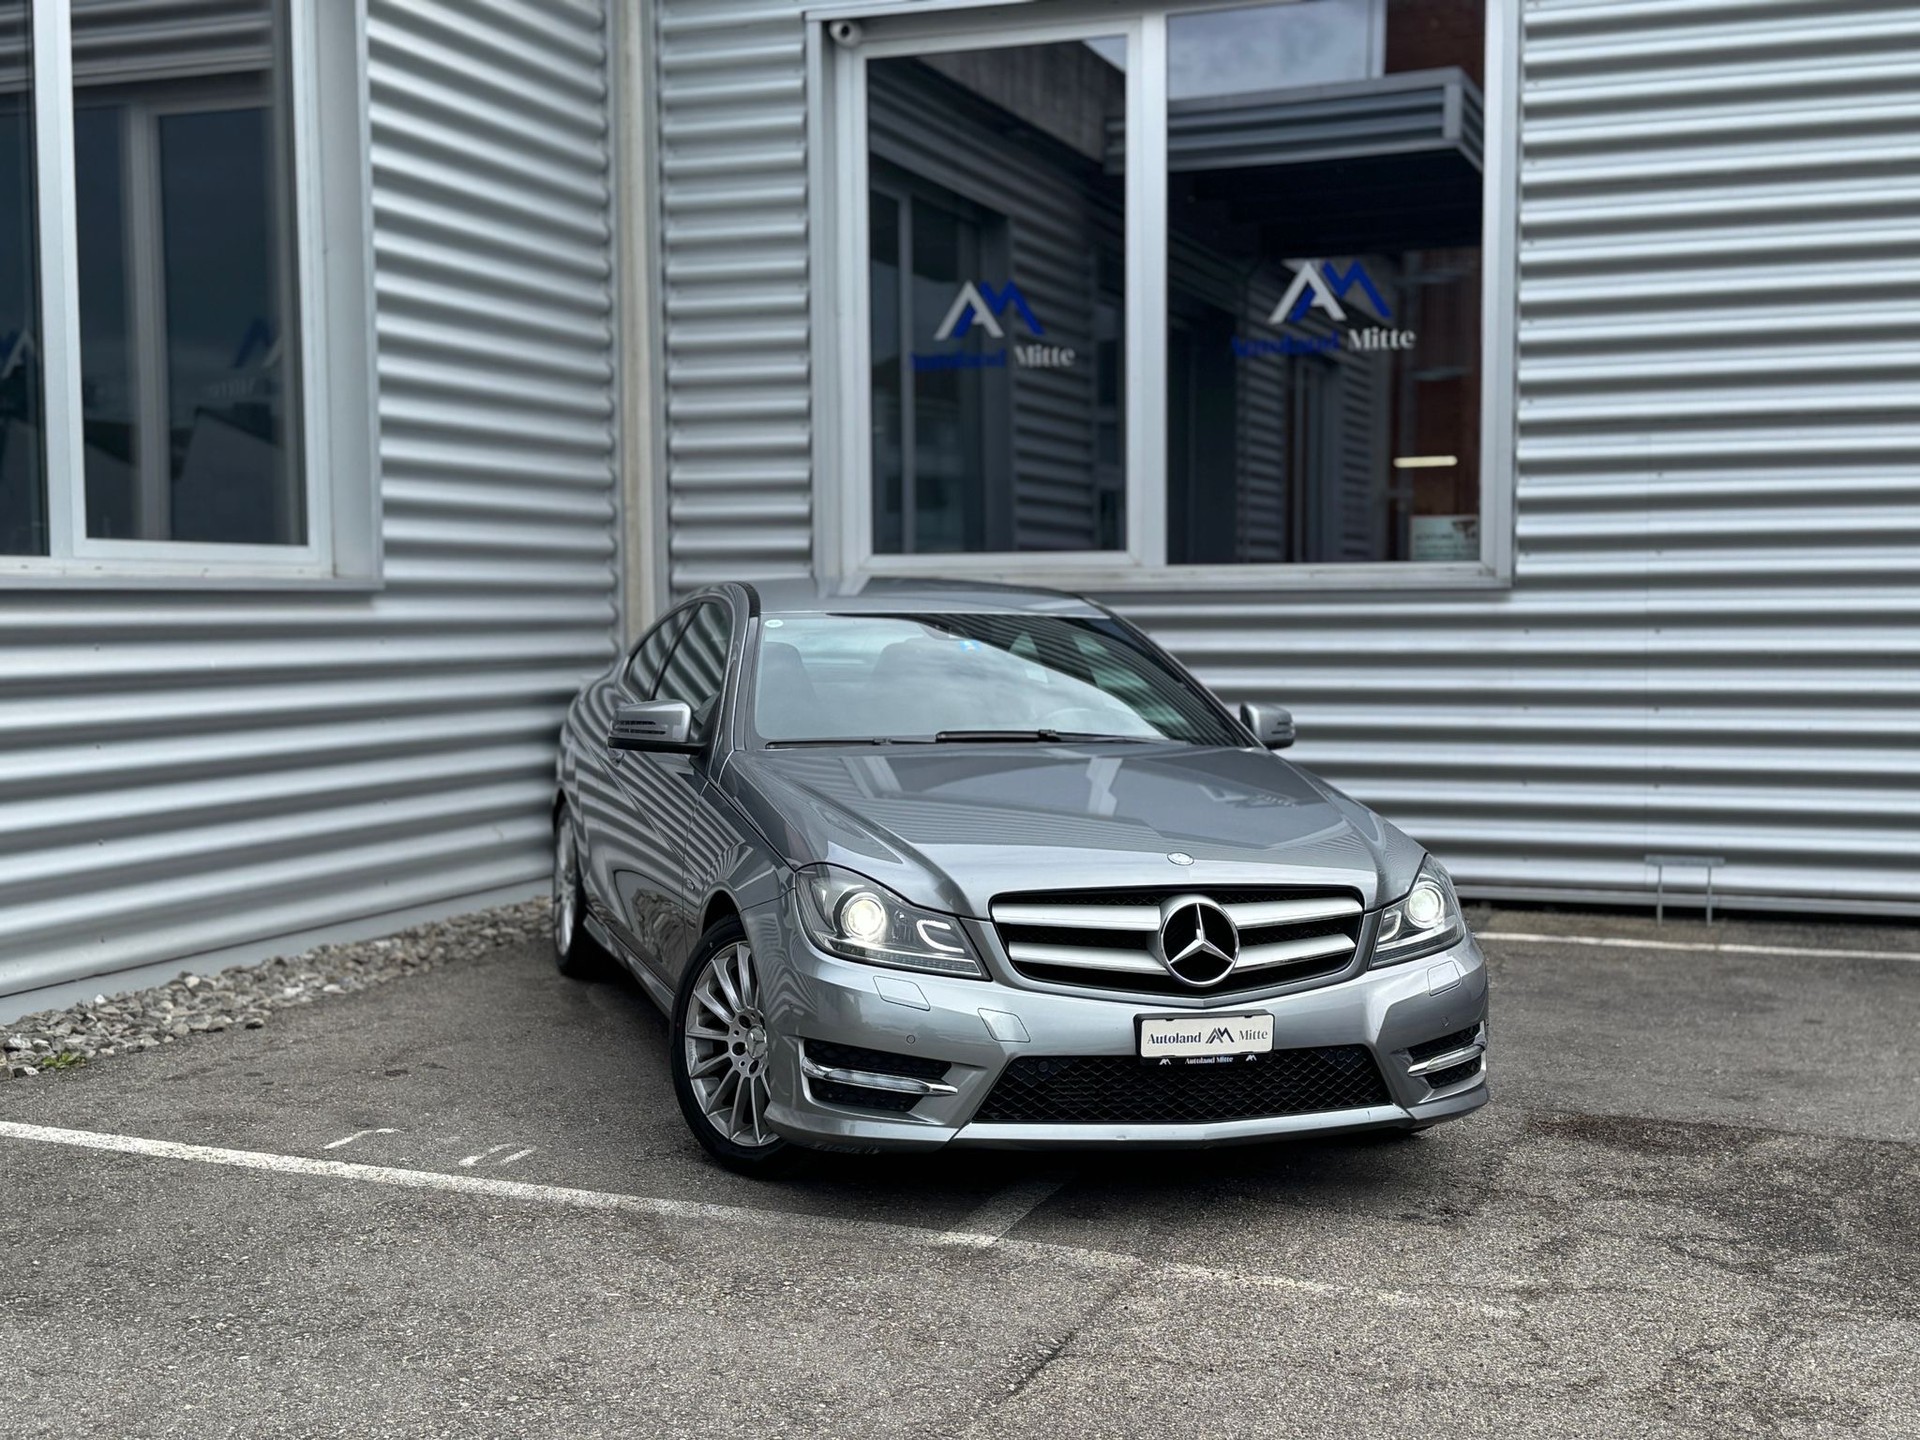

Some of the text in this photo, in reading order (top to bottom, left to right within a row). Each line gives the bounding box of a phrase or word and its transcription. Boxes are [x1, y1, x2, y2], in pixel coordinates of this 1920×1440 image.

[1349, 326, 1416, 350] Mitte
[1015, 345, 1075, 367] Mitte
[1147, 1032, 1202, 1045] Autoland
[1238, 1029, 1268, 1041] Mitte
[1184, 1056, 1215, 1065] Autoland
